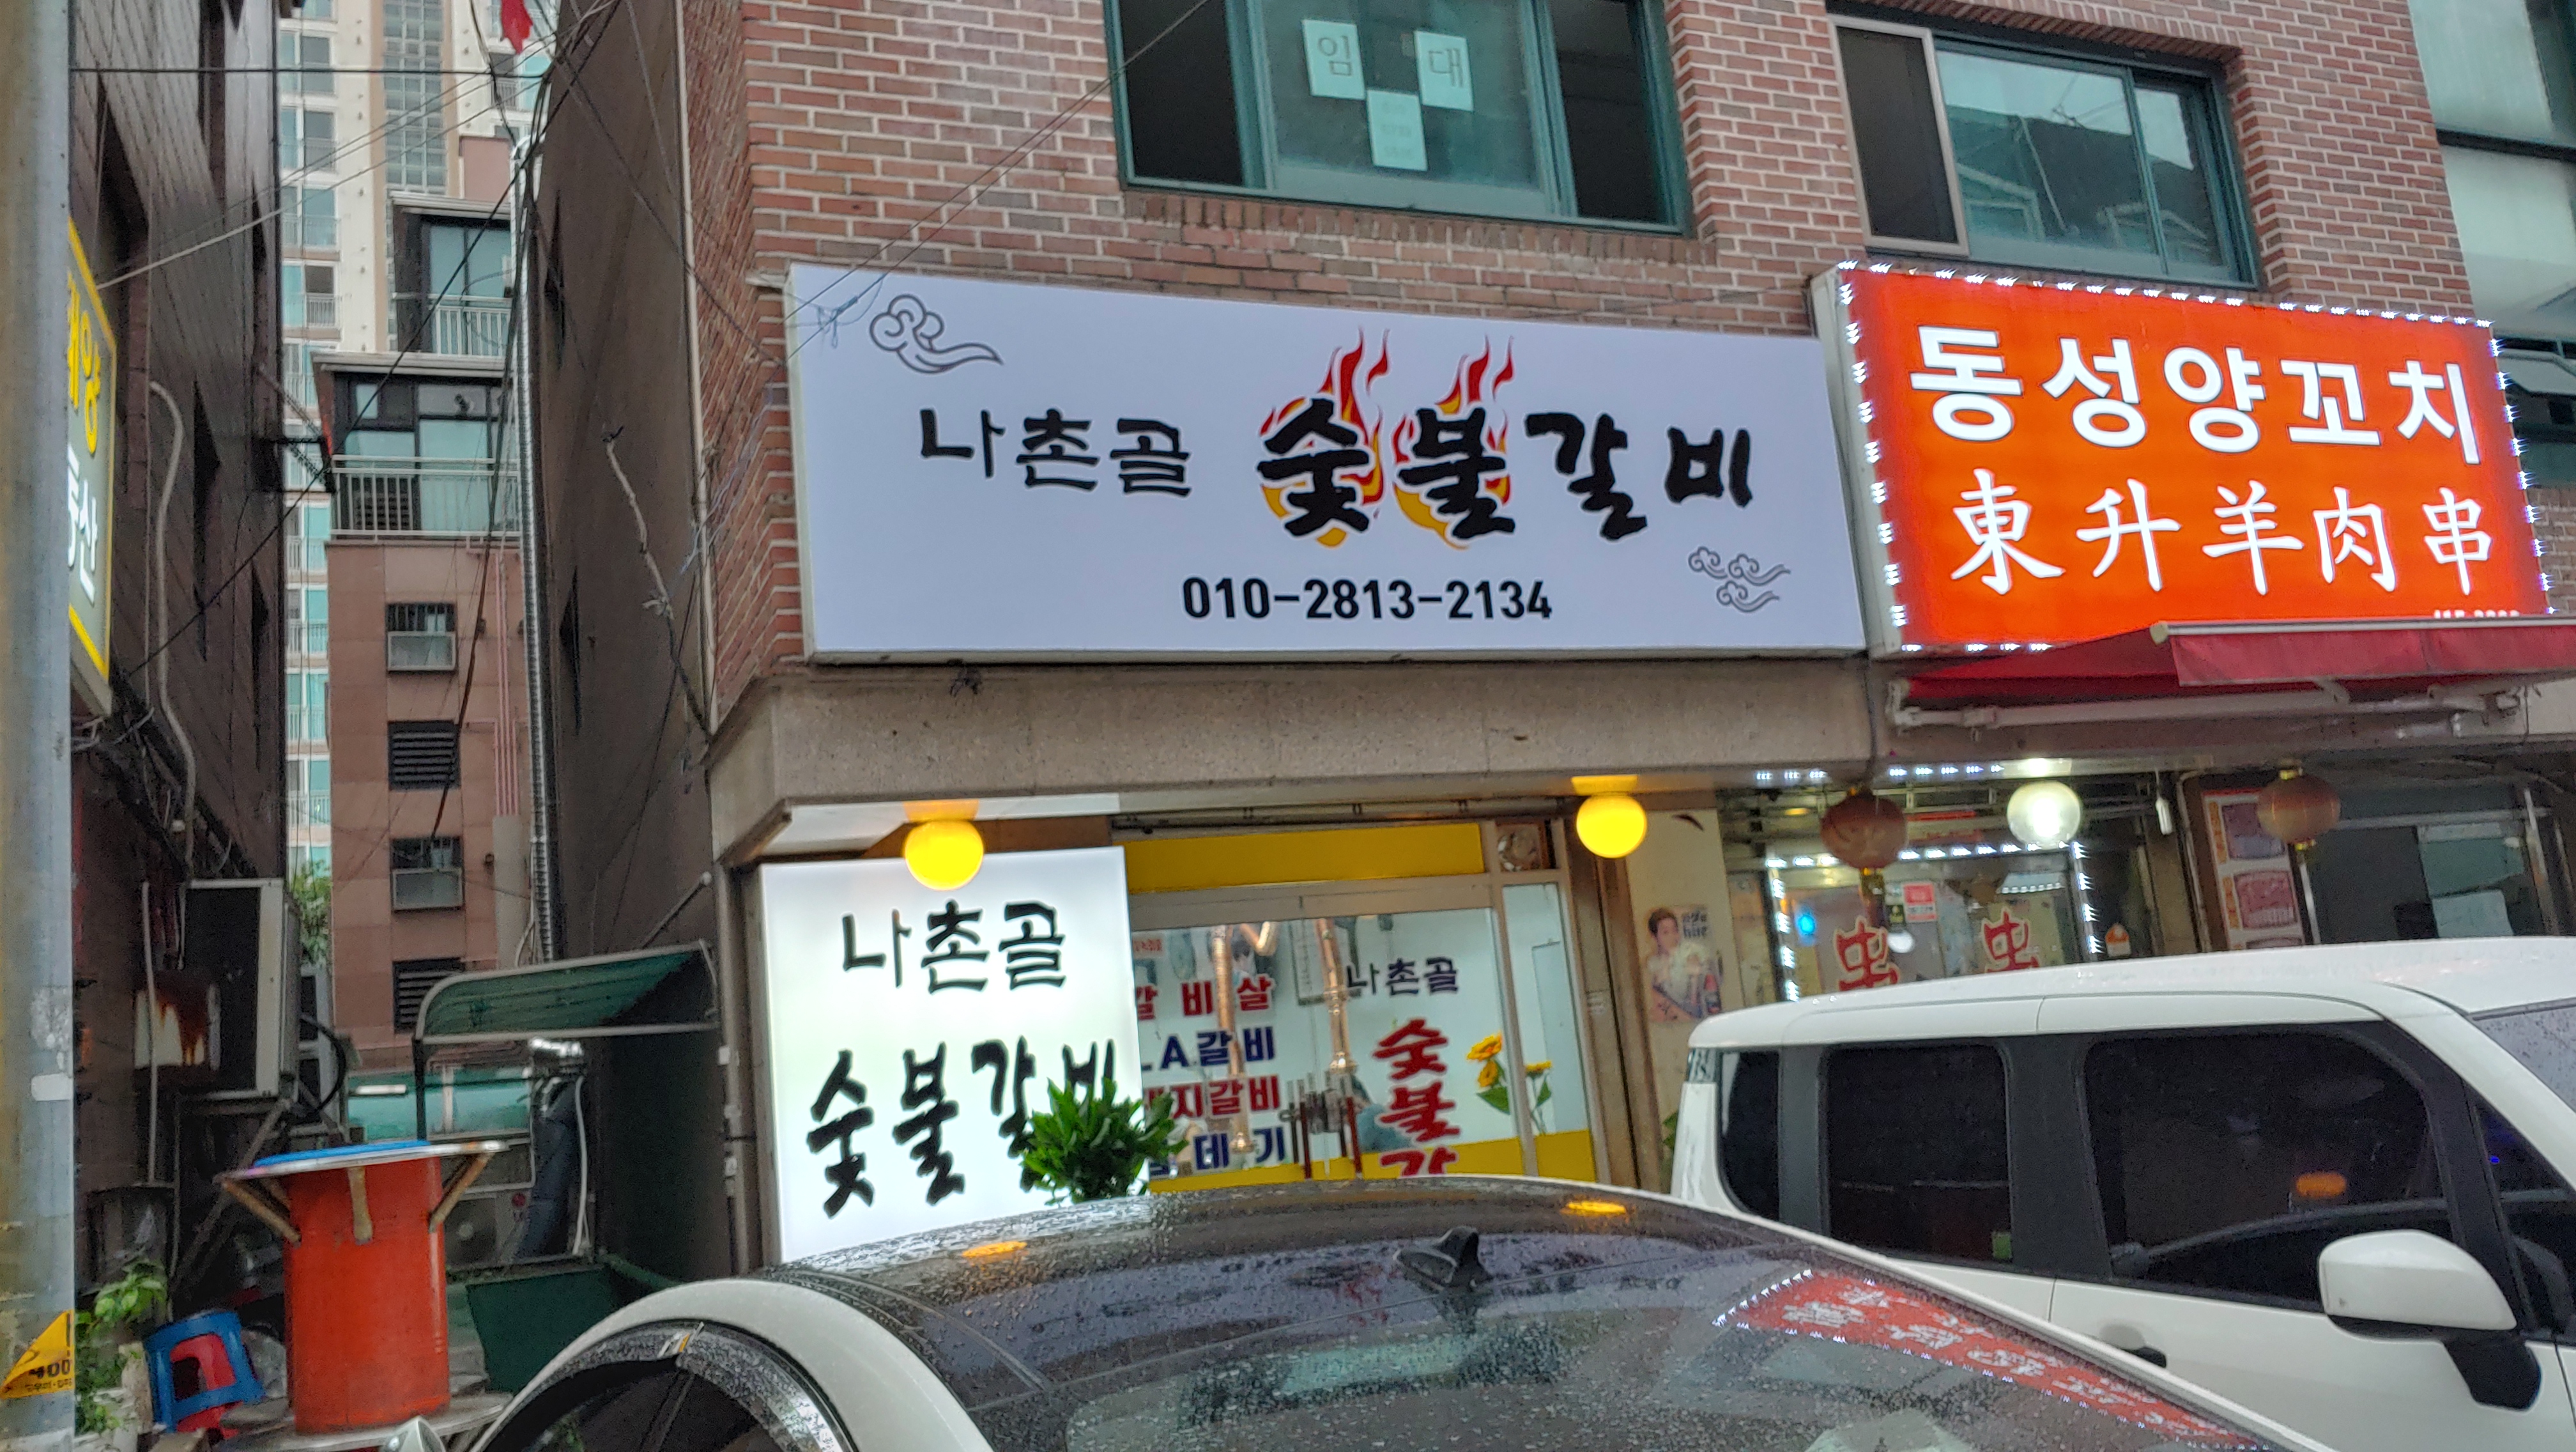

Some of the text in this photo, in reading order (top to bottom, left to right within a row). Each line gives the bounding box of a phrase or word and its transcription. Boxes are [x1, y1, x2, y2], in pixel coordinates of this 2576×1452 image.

[1908, 323, 2483, 467] 동성양꼬치
[920, 408, 1192, 497] 나촌골
[1256, 398, 1754, 542] 숯불갈비
[1950, 467, 2494, 597] 東升羊肉串
[1182, 576, 1553, 620] 010-2813-2134
[841, 899, 1066, 994] 나촌골
[1346, 957, 1459, 996] 나촌골
[1144, 1075, 1280, 1119] 지갈비
